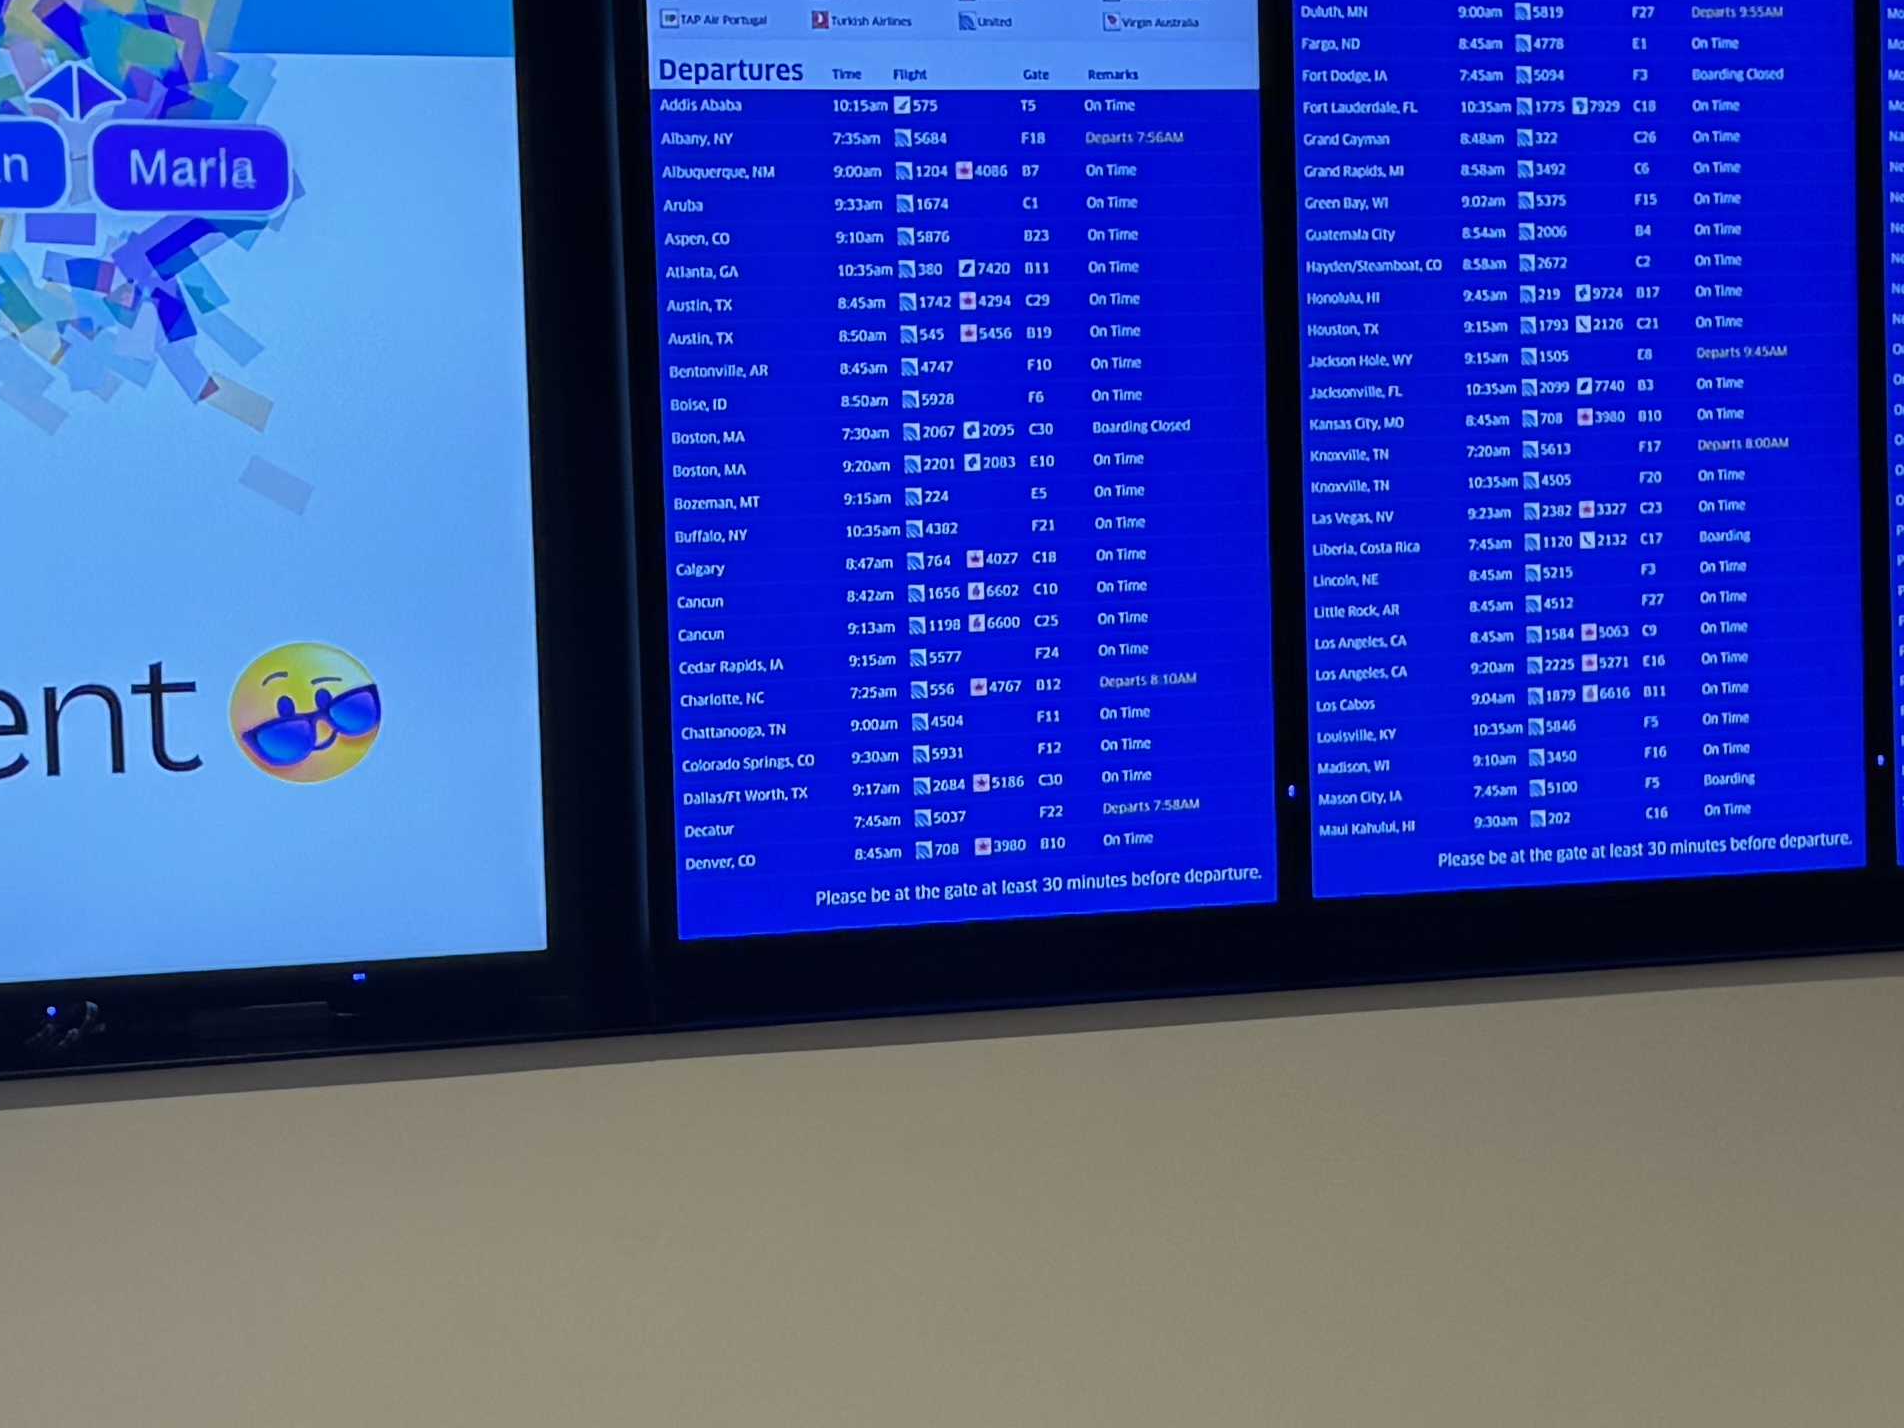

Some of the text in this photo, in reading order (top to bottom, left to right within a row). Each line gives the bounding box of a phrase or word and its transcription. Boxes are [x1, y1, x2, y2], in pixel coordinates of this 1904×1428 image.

[659, 58, 804, 85] Departures
[831, 67, 1139, 82] Time Flight Gate Remarks
[659, 98, 1136, 112] Addis Ababa 10:15am 575 T5 On Time
[671, 418, 1191, 445] Boston, MA 7:30am 2067 2095 C30 Boarding Closed
[1438, 832, 1853, 868] Please be at the gate at least 30 minutes before departure.
[815, 867, 1262, 906] Please be at the gate at least 30 minutes before departure.
